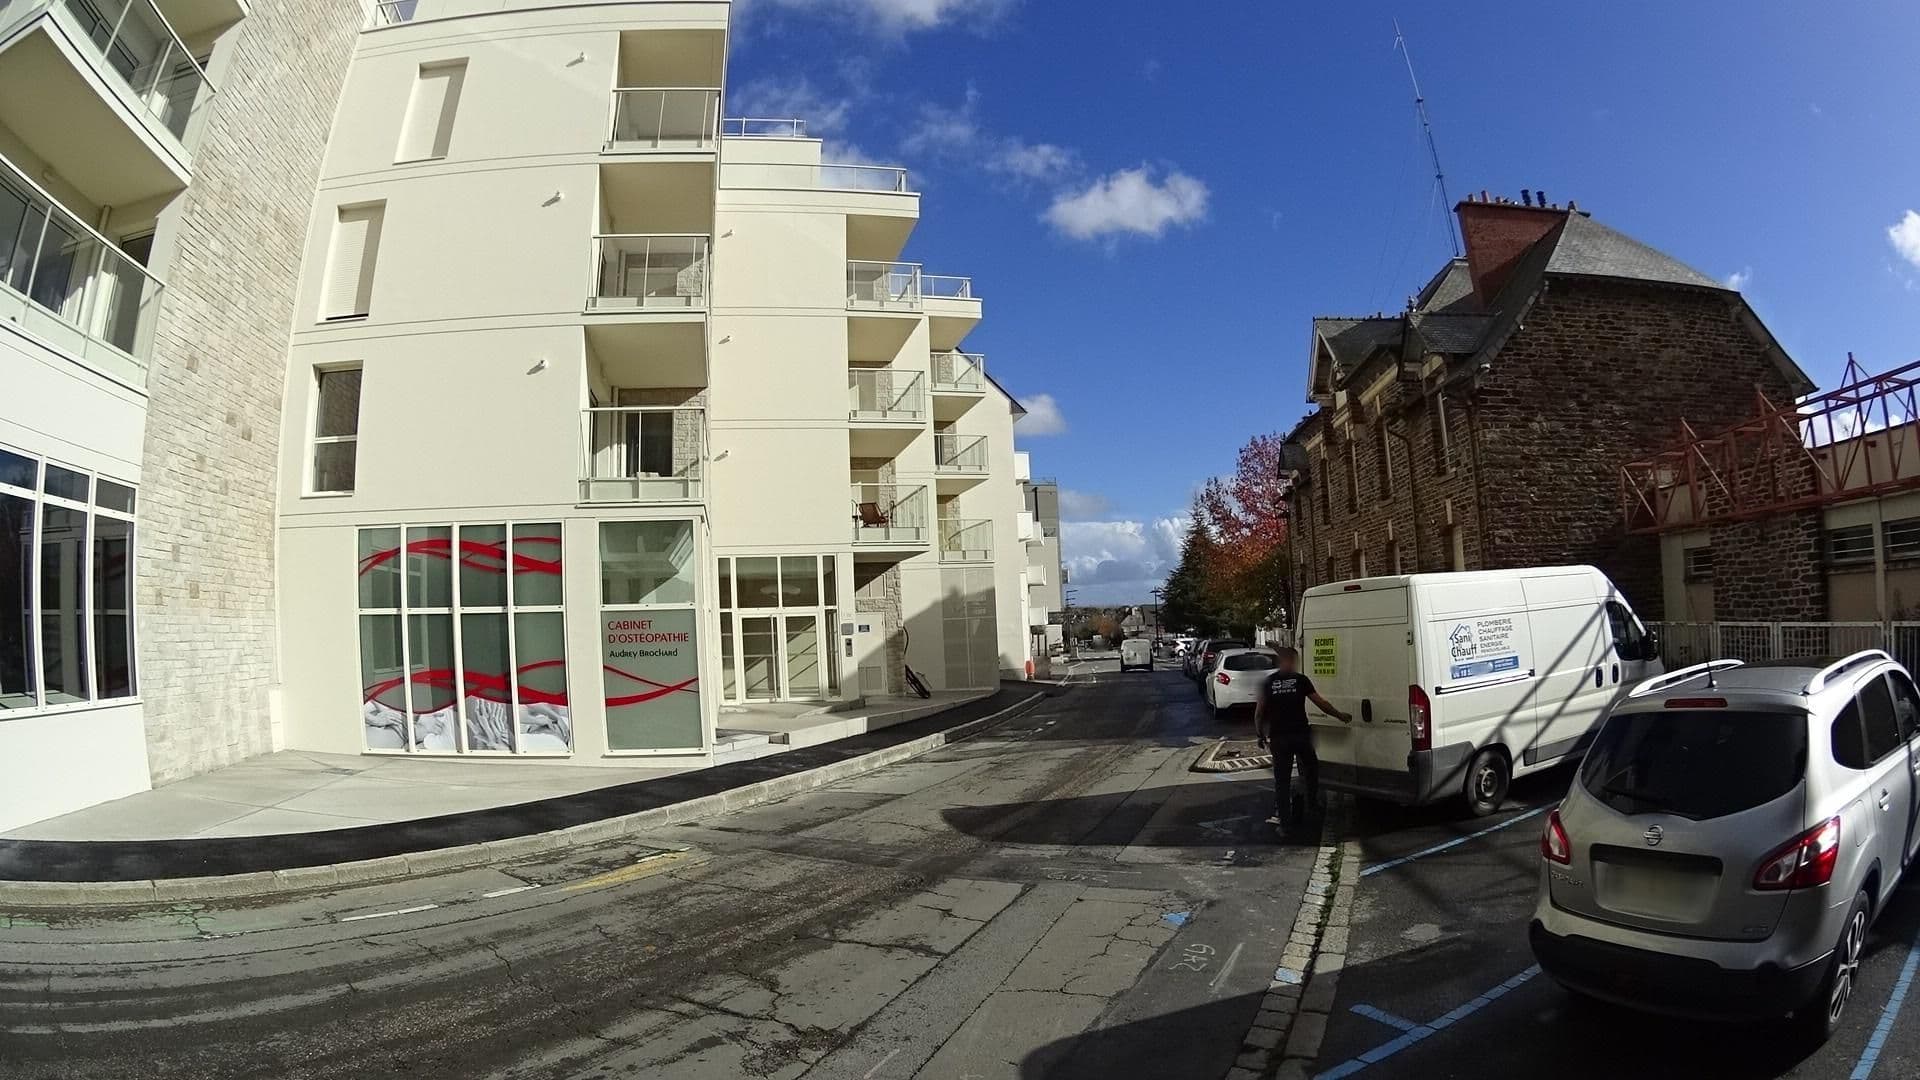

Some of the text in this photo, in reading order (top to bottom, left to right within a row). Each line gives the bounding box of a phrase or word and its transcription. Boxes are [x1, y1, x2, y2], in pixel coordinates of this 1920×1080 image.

[608, 620, 652, 630] CABINET
[1477, 618, 1512, 627] PLOMBERIE
[1479, 625, 1512, 634] CHAUFFAGE
[1479, 633, 1509, 642] SANITAIRE
[1451, 644, 1476, 657] Chauff
